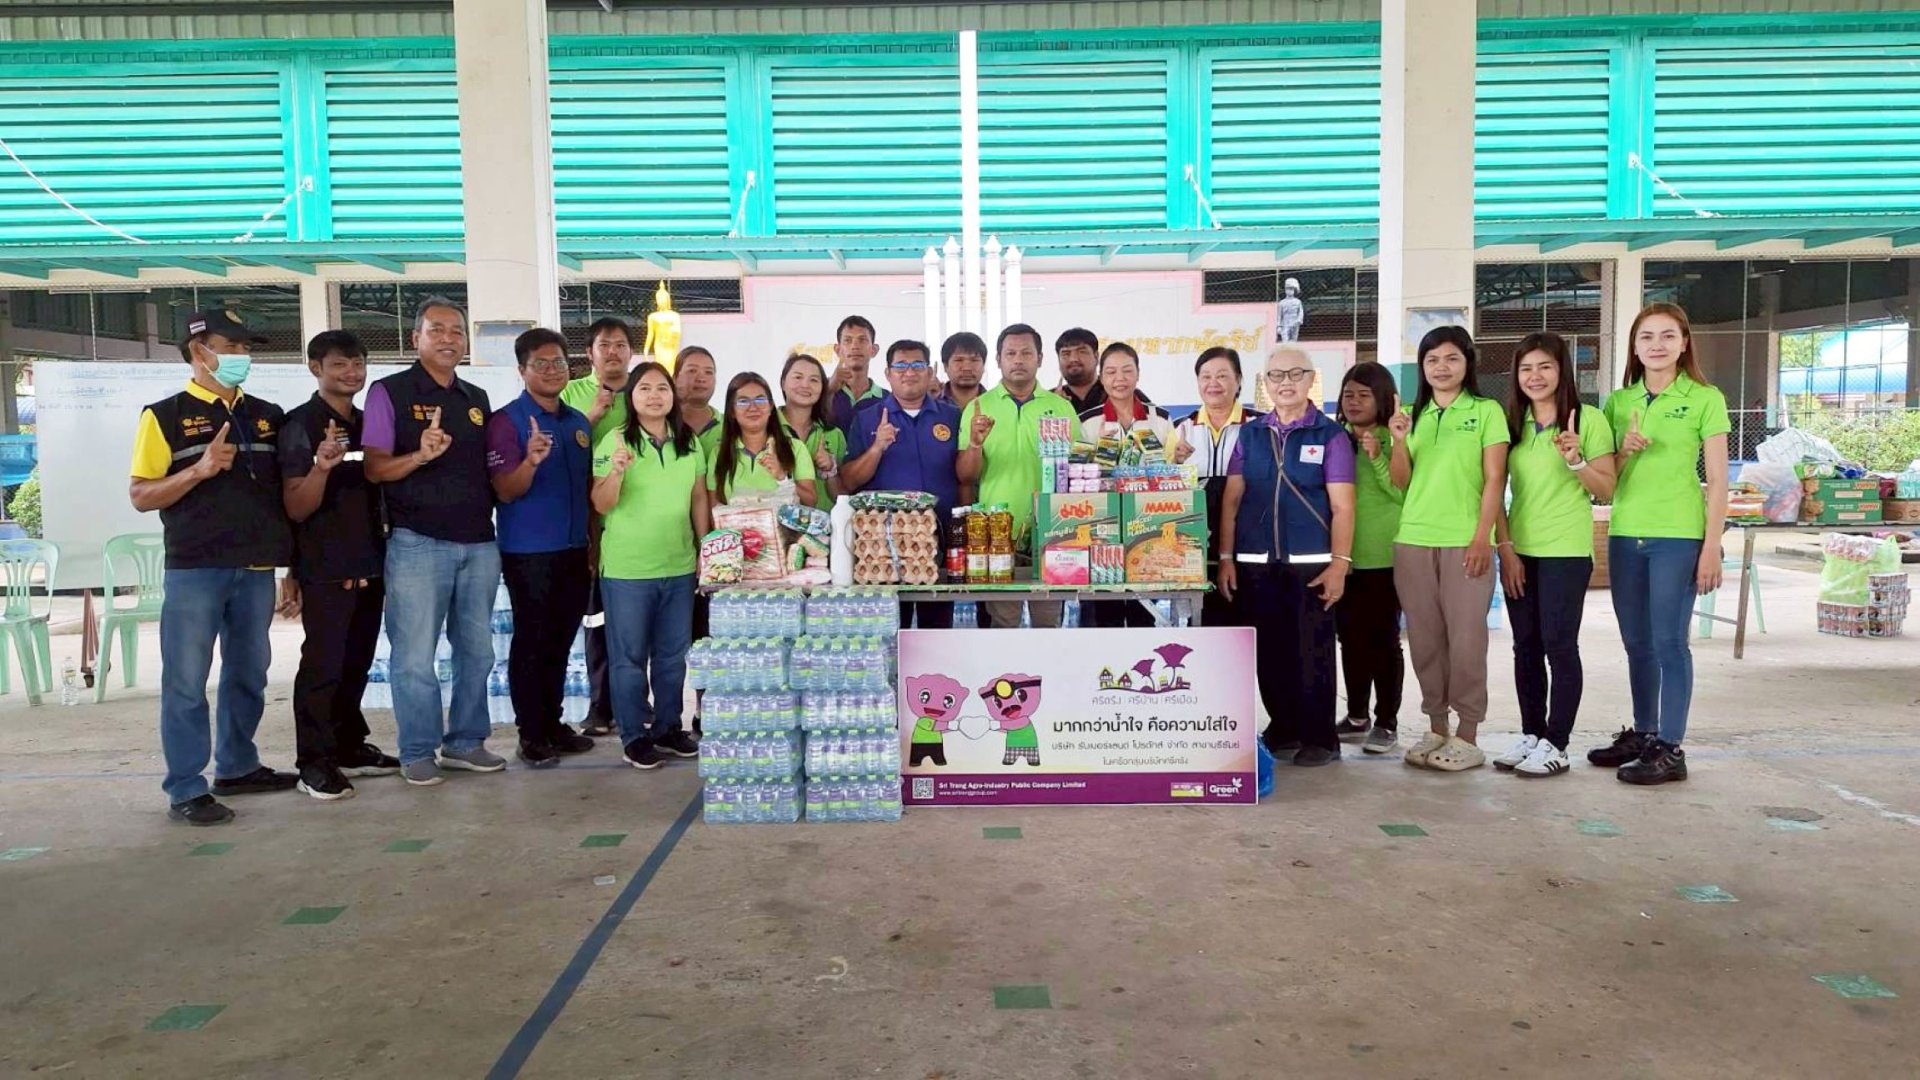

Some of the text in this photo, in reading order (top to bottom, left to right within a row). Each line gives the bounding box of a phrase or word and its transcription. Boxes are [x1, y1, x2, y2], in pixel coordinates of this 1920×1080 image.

[1060, 500, 1094, 518] มาม่า
[1144, 502, 1184, 514] MAMA
[1053, 713, 1238, 733] มากกว่าน้ำใจ คือความใส่ใจ
[1052, 740, 1075, 751] บริษัท
[949, 782, 967, 790] Trang
[1011, 781, 1031, 789] Public
[1032, 781, 1061, 790] Company
[1209, 784, 1240, 794] Green
